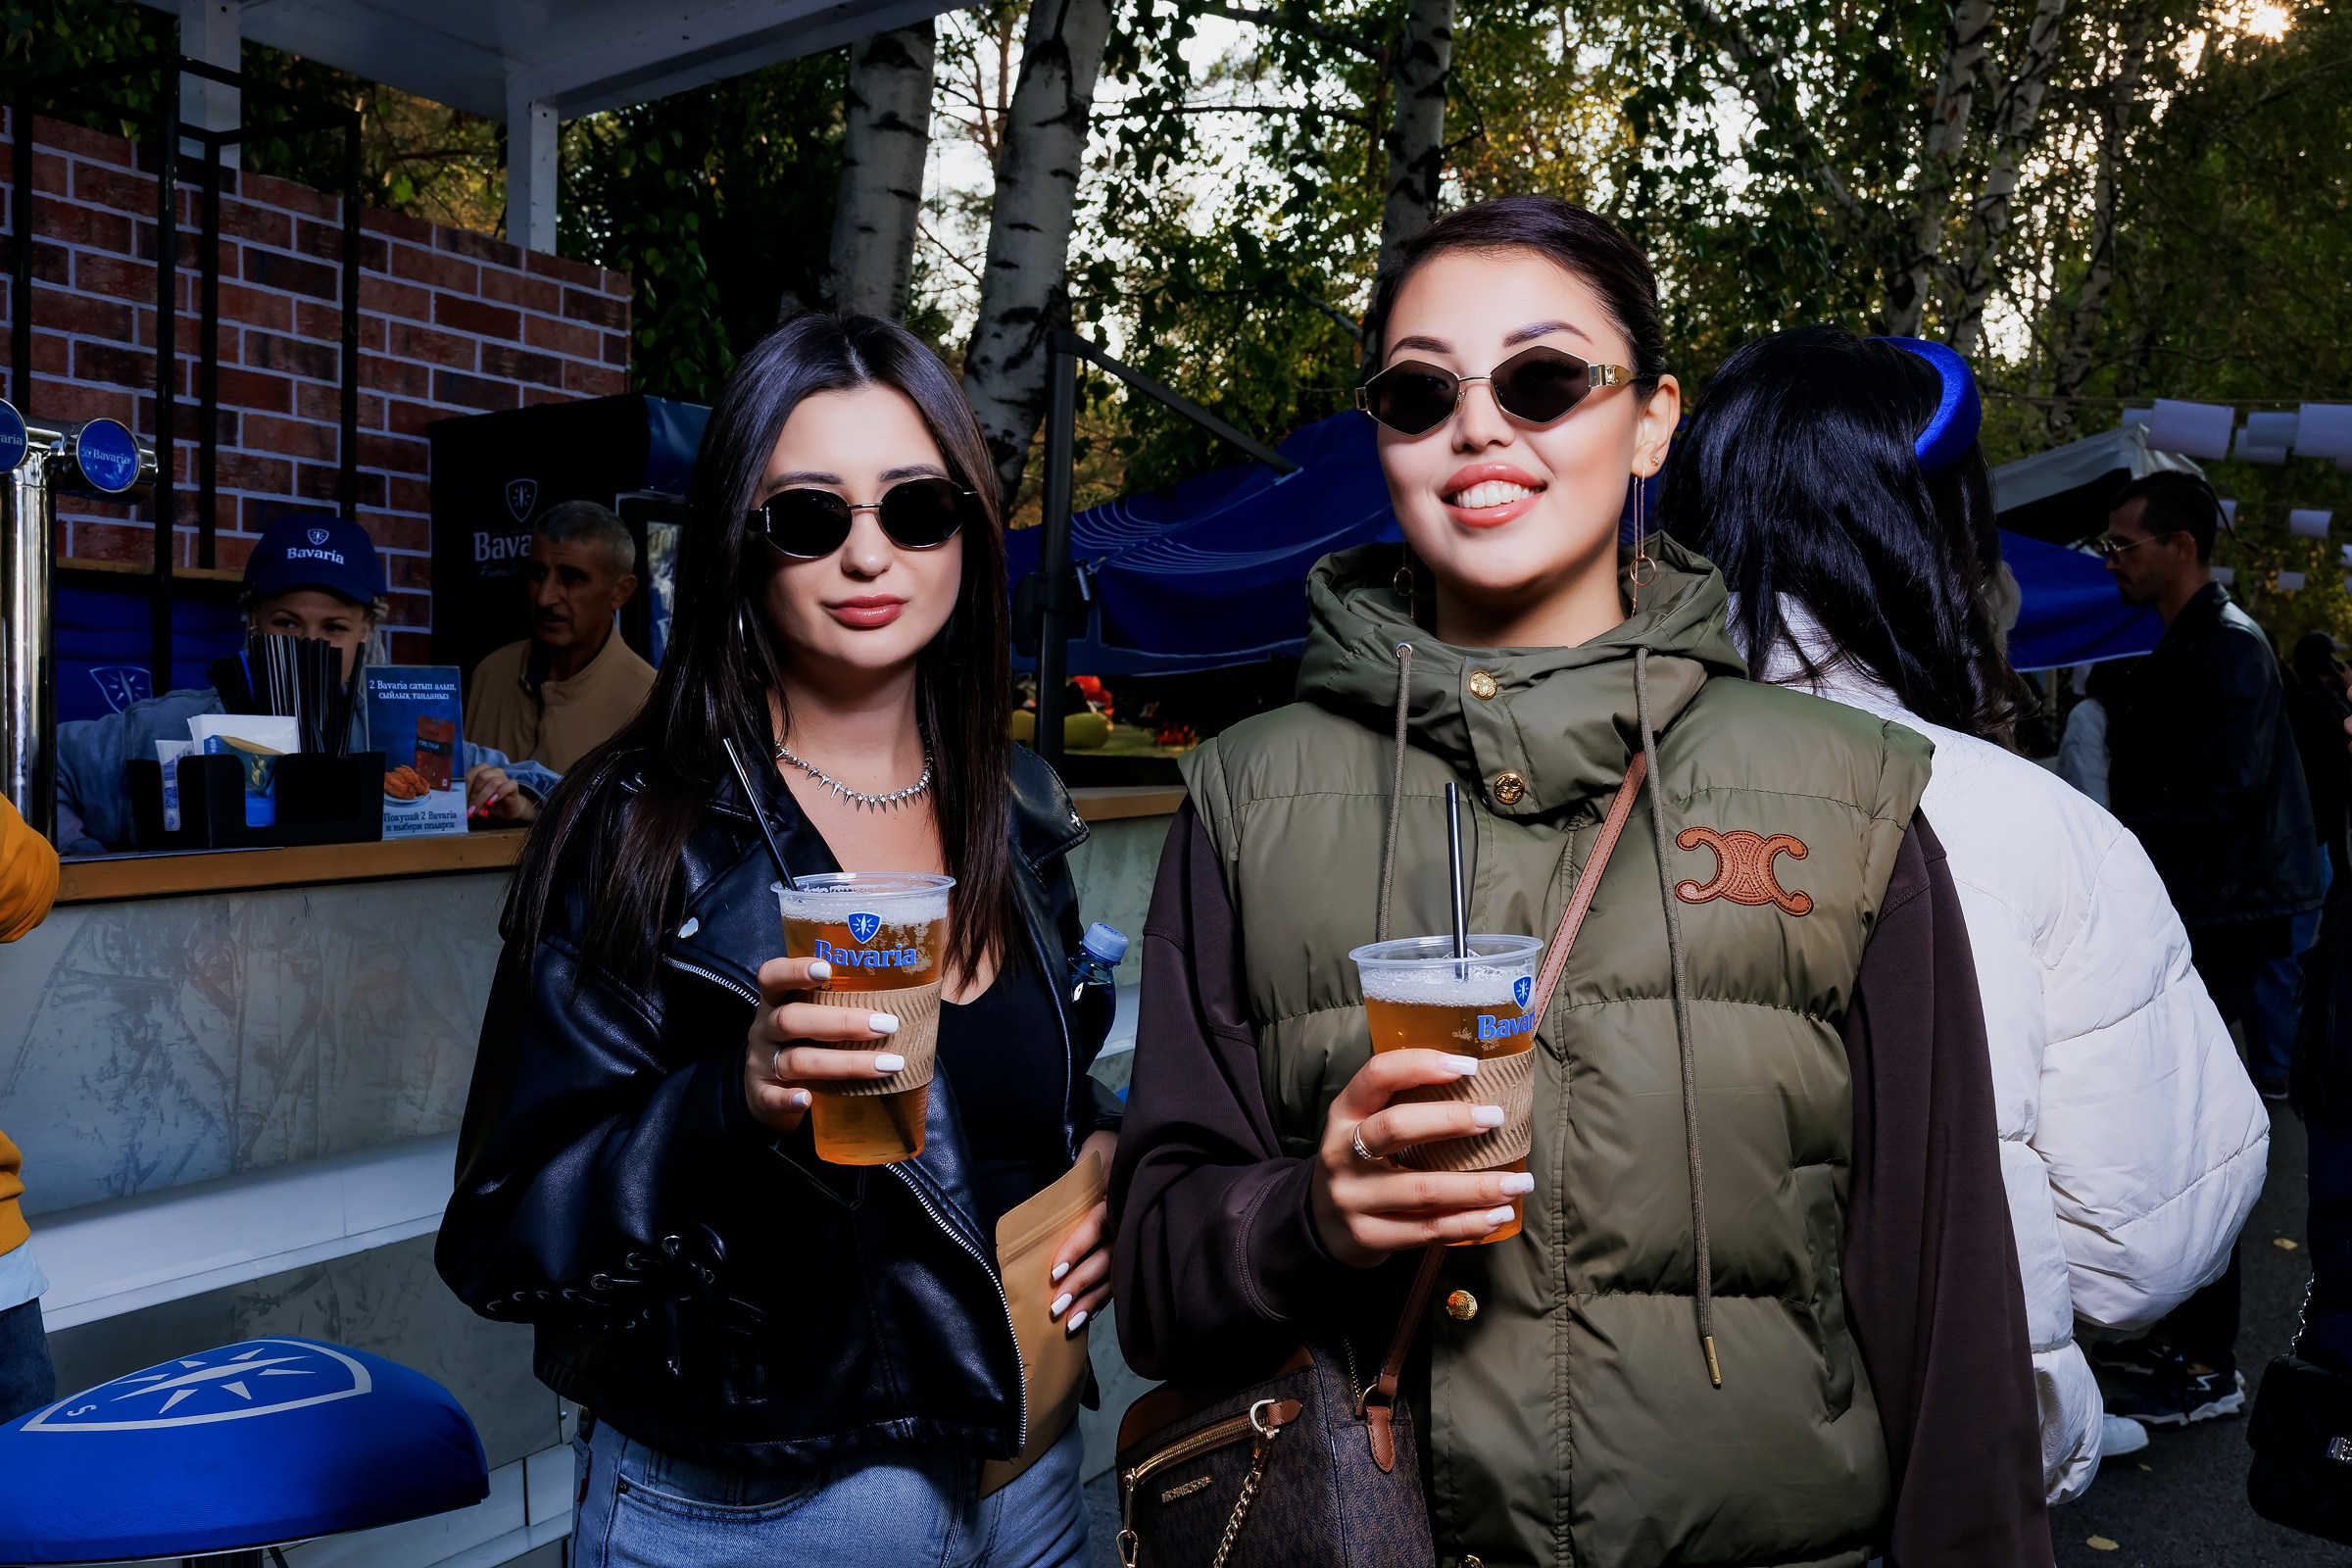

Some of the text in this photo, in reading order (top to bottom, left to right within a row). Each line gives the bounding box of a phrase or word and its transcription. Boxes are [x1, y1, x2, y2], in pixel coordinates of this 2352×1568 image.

[0, 433, 24, 446] aria
[92, 448, 132, 465] Bavaria
[472, 531, 532, 563] Bava
[286, 547, 345, 565] Bavaria
[368, 679, 375, 690] 2
[376, 679, 408, 690] Bavaria
[383, 809, 458, 823] Покупай 2 Bavaria
[393, 822, 422, 833] выбери
[424, 821, 456, 831] подарок
[814, 938, 917, 968] Bavaria
[1476, 1009, 1536, 1041] Bavar
